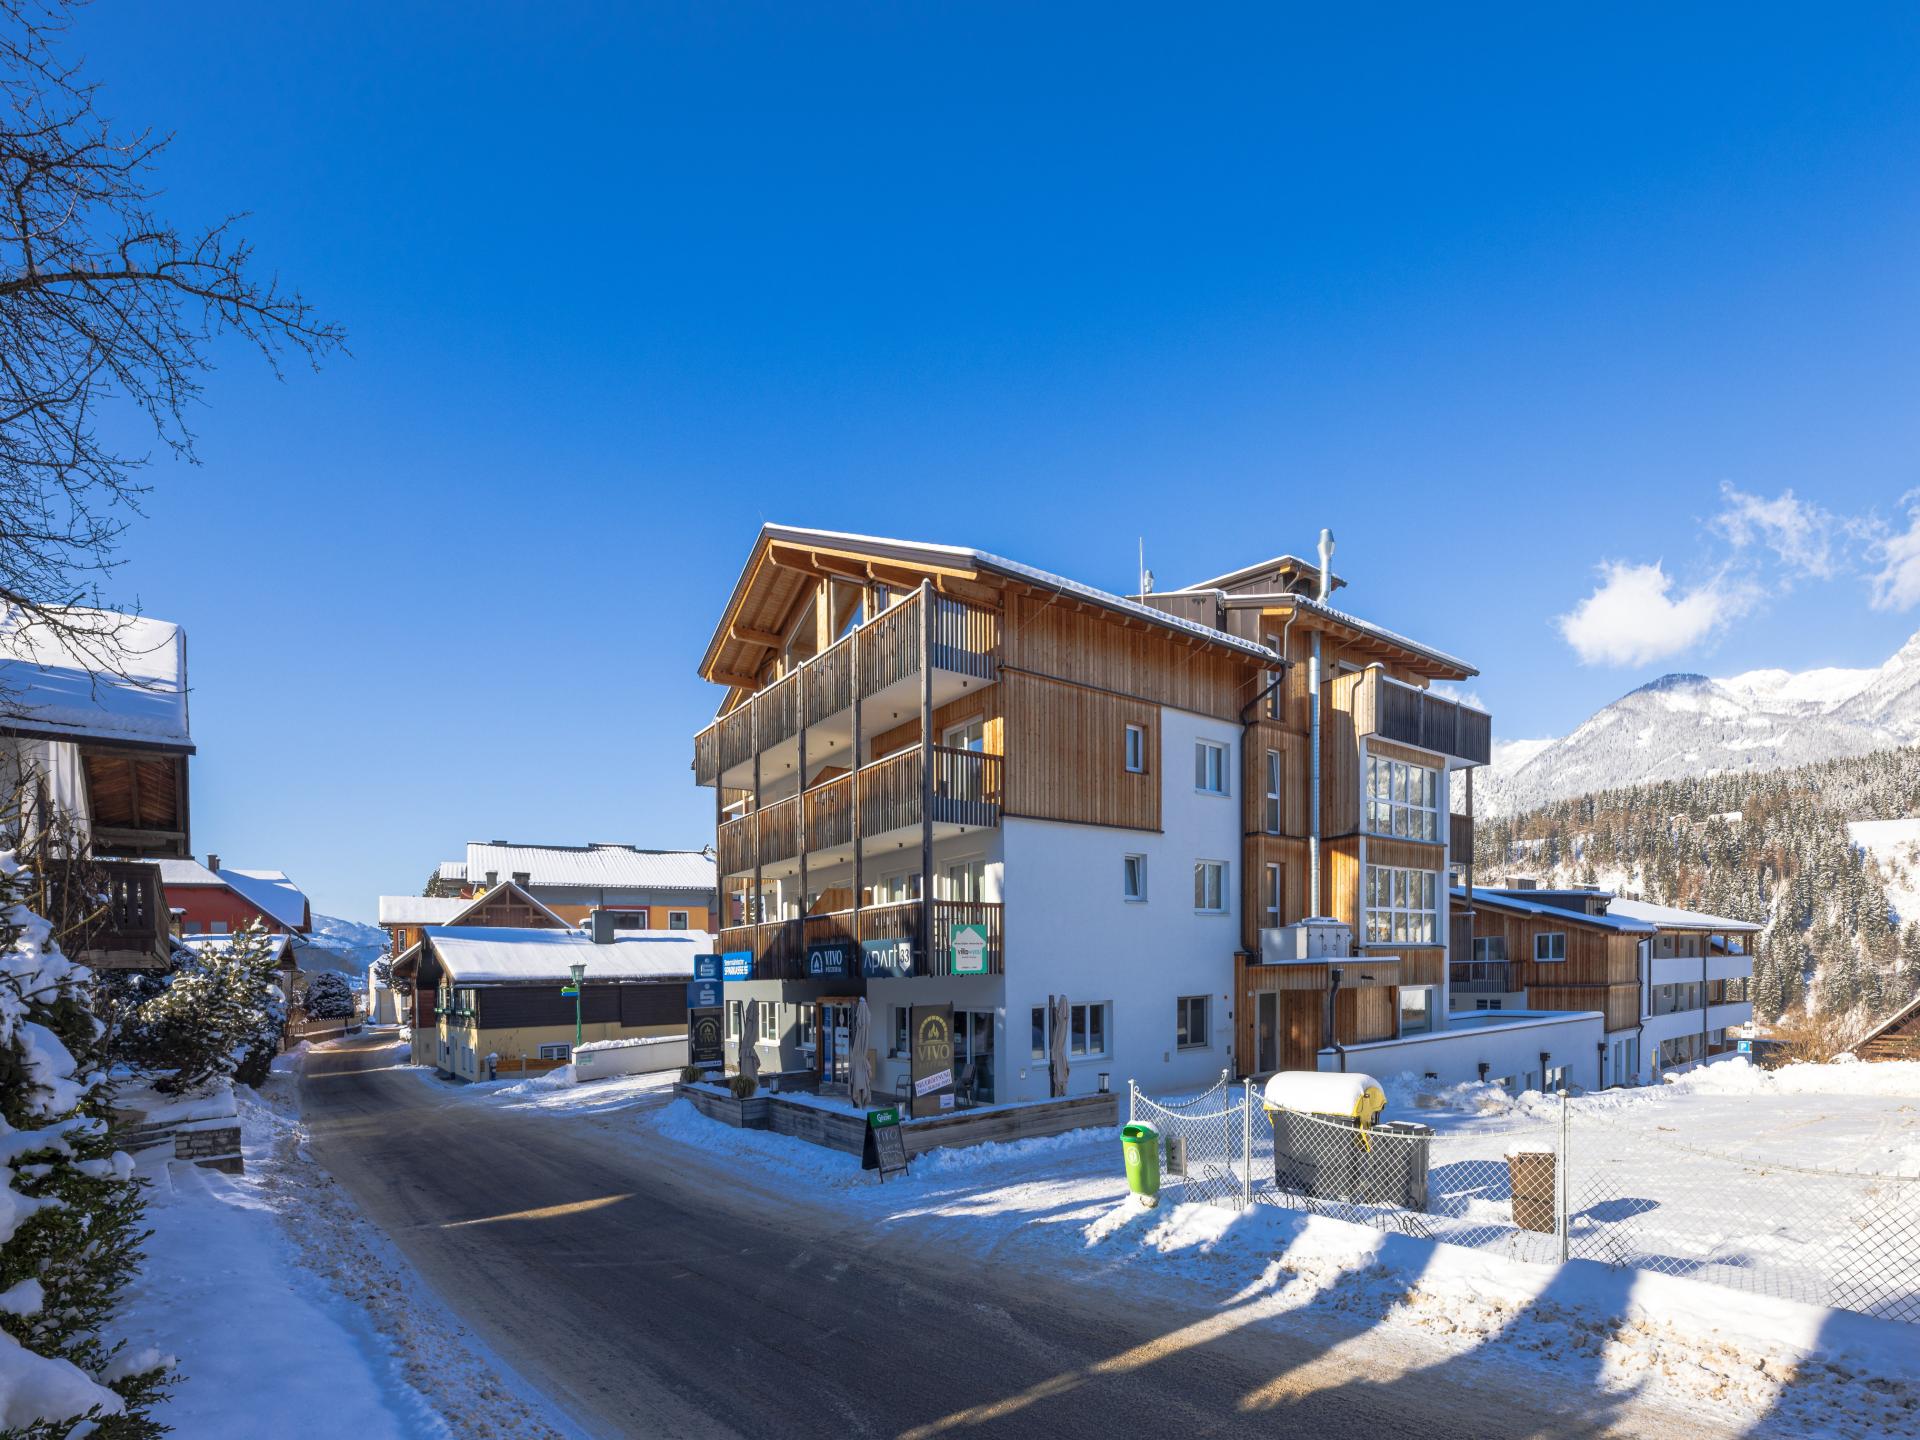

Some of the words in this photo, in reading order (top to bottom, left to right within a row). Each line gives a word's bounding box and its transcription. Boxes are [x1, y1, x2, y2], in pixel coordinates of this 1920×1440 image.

[824, 949, 842, 966] VIVO
[900, 949, 910, 963] 33
[917, 1044, 950, 1061] VIVO
